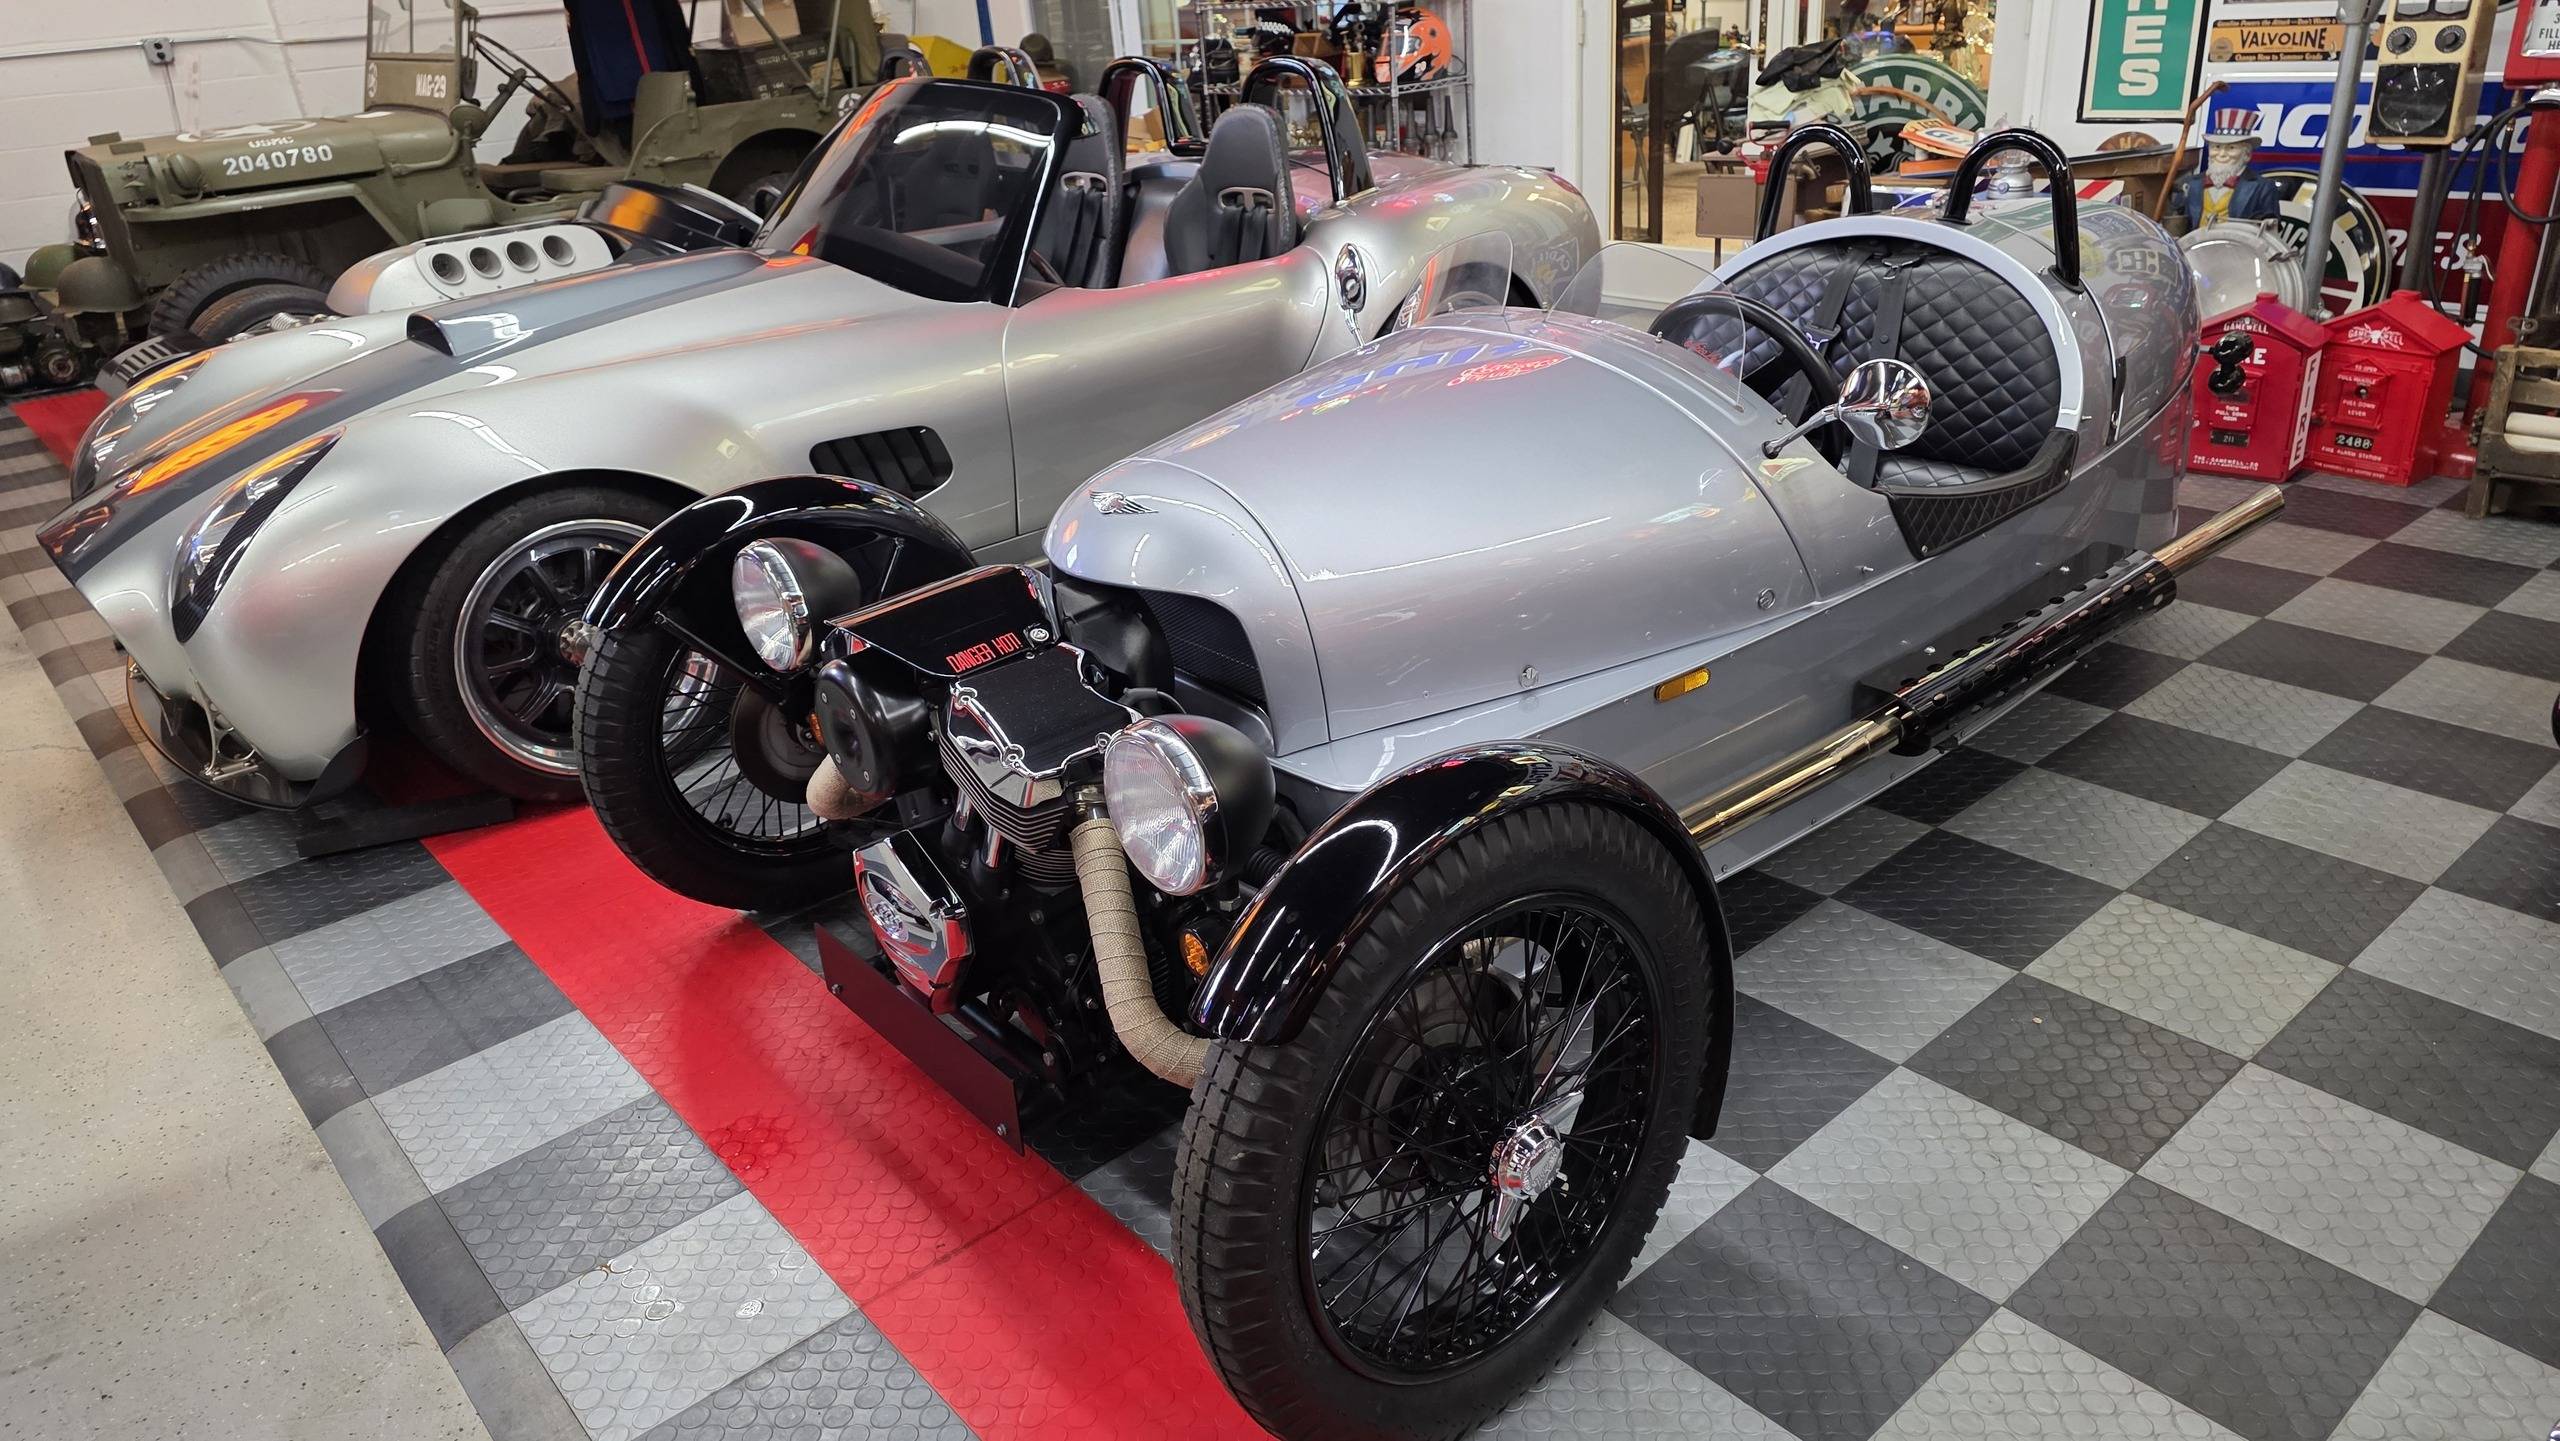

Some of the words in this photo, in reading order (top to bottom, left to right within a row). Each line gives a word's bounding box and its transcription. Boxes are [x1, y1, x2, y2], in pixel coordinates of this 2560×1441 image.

[2117, 0, 2169, 97] ES
[2240, 28, 2328, 50] VALVOLINE
[222, 144, 334, 176] 2040780
[2293, 358, 2317, 462] FIRE
[946, 642, 996, 673] DANGER
[992, 632, 1024, 656] HOT!
